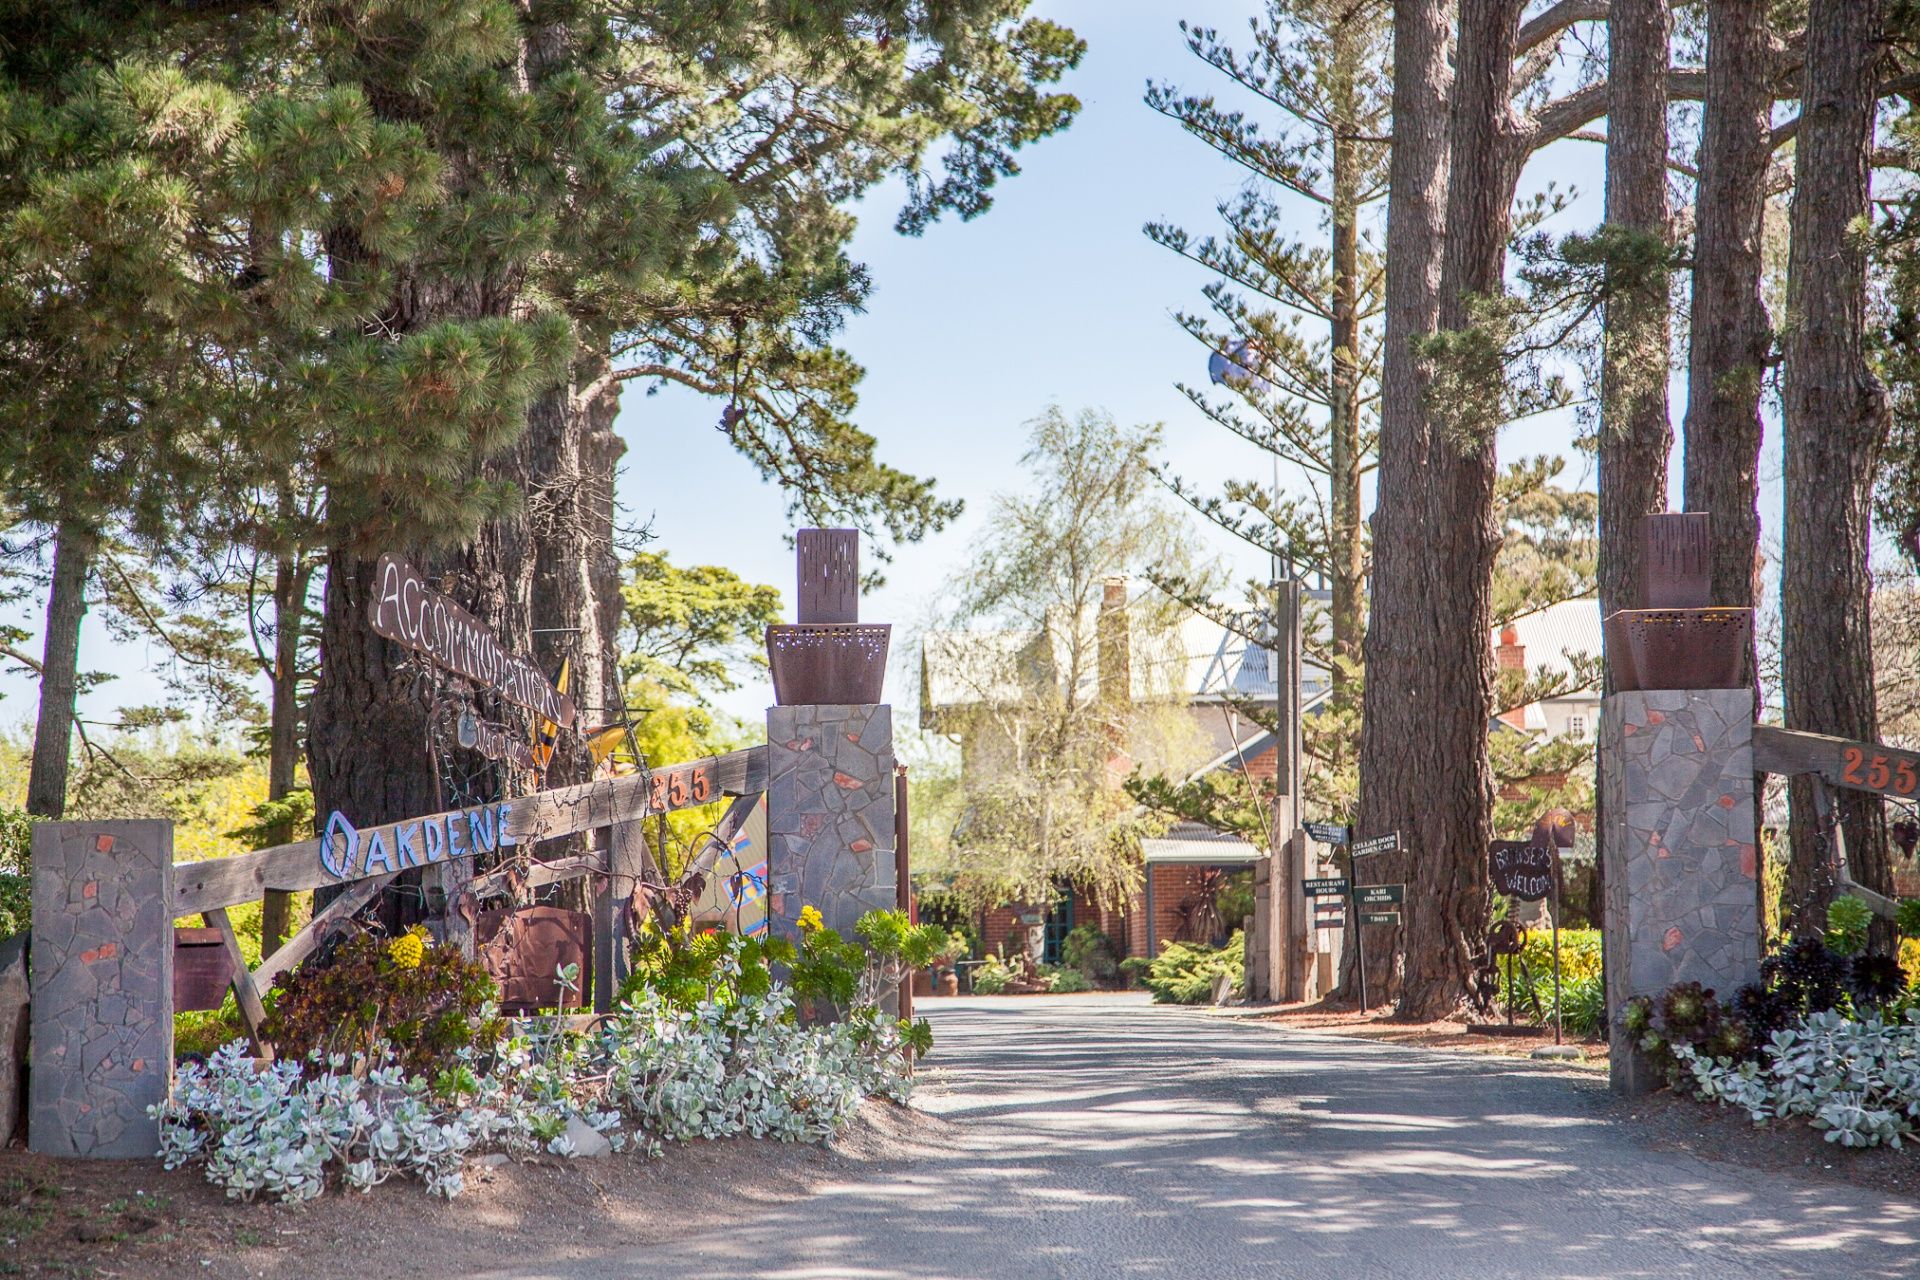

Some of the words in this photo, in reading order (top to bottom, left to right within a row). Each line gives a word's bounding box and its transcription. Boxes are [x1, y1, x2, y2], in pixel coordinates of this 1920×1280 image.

[1843, 747, 1917, 794] 255
[649, 767, 709, 810] 255
[320, 804, 516, 879] OAKDENE
[1352, 840, 1378, 851] CELLAR
[1378, 834, 1397, 844] DOOR
[1352, 845, 1378, 857] GARDEN
[1378, 841, 1396, 852] CAFE
[1305, 880, 1345, 889] RESTAURANT
